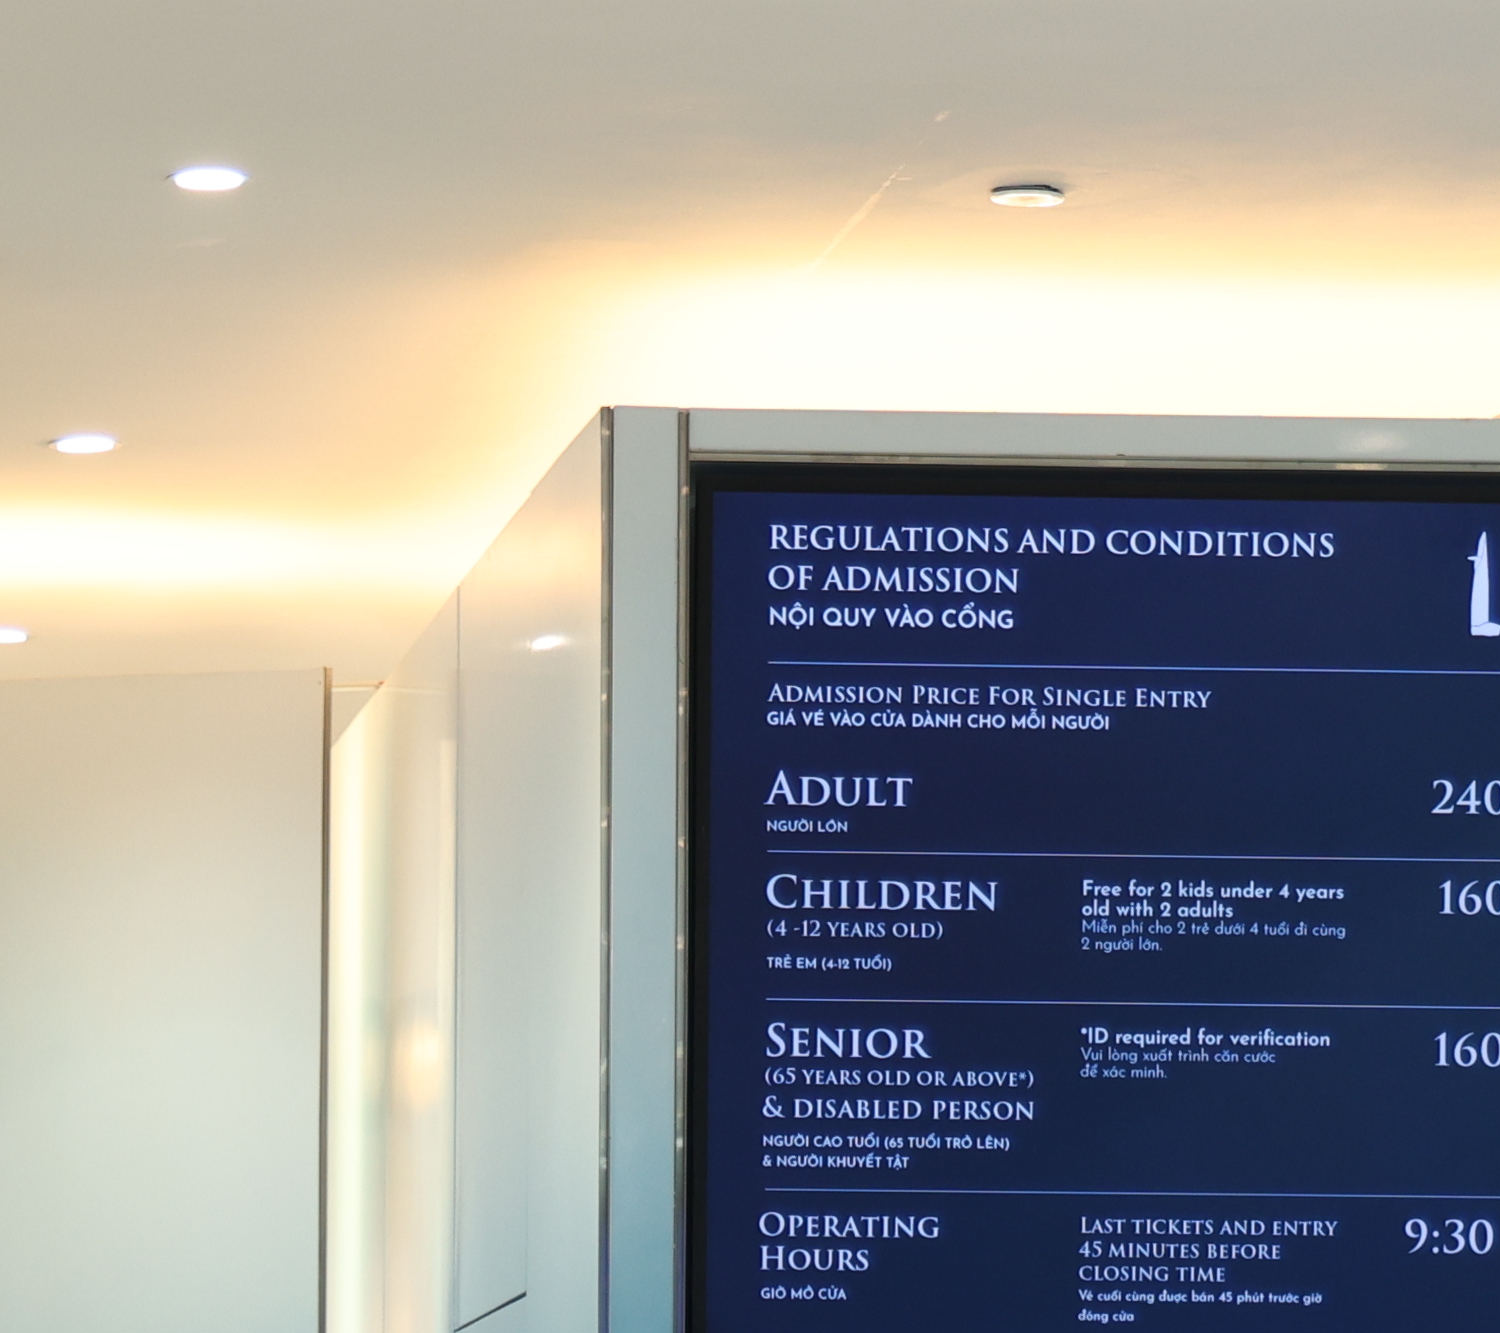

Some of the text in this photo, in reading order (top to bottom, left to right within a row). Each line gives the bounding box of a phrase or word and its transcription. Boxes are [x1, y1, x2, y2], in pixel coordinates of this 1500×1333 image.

[771, 525, 1334, 558] REGULATIONS AND CONDITIONS
[769, 565, 1018, 594] OF ADMISSION
[770, 602, 1013, 630] NỘI QUY VÀO CỔNG
[769, 683, 1211, 709] ADMISSION PRICE FOR SINGLE ENTRY
[767, 708, 1109, 730] GIÁ VÉ VÀO CỬA DÀNH CHO MỖI NGƯỜI
[765, 770, 912, 807] ADULT
[767, 818, 813, 832] NGƯỜI
[767, 874, 997, 912] CHILDREN
[1083, 880, 1344, 903] Free for 2 kids under 4 years
[1082, 900, 1234, 918] old with 2 adults
[828, 921, 885, 938] YEARS
[893, 921, 943, 939] OLD)
[1082, 920, 1345, 940] Miễn phí cho 2 trẻ dưới 4 tuổi đi cùng
[1081, 936, 1162, 953] 2 người lớn.
[767, 954, 791, 969] TRẺ
[797, 957, 816, 969] EM
[854, 954, 891, 972] TUỔI)
[767, 1022, 930, 1060] SENIOR
[1114, 1028, 1190, 1048] required
[1198, 1029, 1223, 1045] for
[1230, 1029, 1331, 1047] verification
[1081, 1048, 1275, 1065] Vui lòng xuất trình căn cước
[765, 1067, 795, 1085] (65
[802, 1069, 860, 1085] YEARS
[868, 1070, 910, 1085] OLD
[917, 1071, 946, 1086] OR
[1080, 1062, 1166, 1079] để xác minh.
[763, 1095, 1033, 1121] & DISABLED PERSON
[763, 1133, 809, 1147] NGƯỜI
[814, 1135, 842, 1148] CAO
[847, 1132, 880, 1149] TUỔI
[884, 1136, 904, 1151] (65
[908, 1132, 940, 1149] TUỔI
[977, 1134, 1009, 1151] LÊN)
[763, 1152, 909, 1170] & NGƯỜI KHUYẾT TẬT
[759, 1212, 938, 1239] OPERATING
[1082, 1217, 1337, 1236] LAST TICKETS AND ENTRY
[1405, 1218, 1493, 1255] 9:30
[762, 1246, 868, 1271] HOURS
[1079, 1241, 1280, 1259] 45 MINUTES BEFORE
[1079, 1265, 1224, 1282] CLOSING TIME
[818, 1284, 846, 1300] CỬA
[1079, 1289, 1322, 1306] Vé cuối cùng bán 45 phút trước giờ
[1078, 1309, 1134, 1324] đóng cửa
